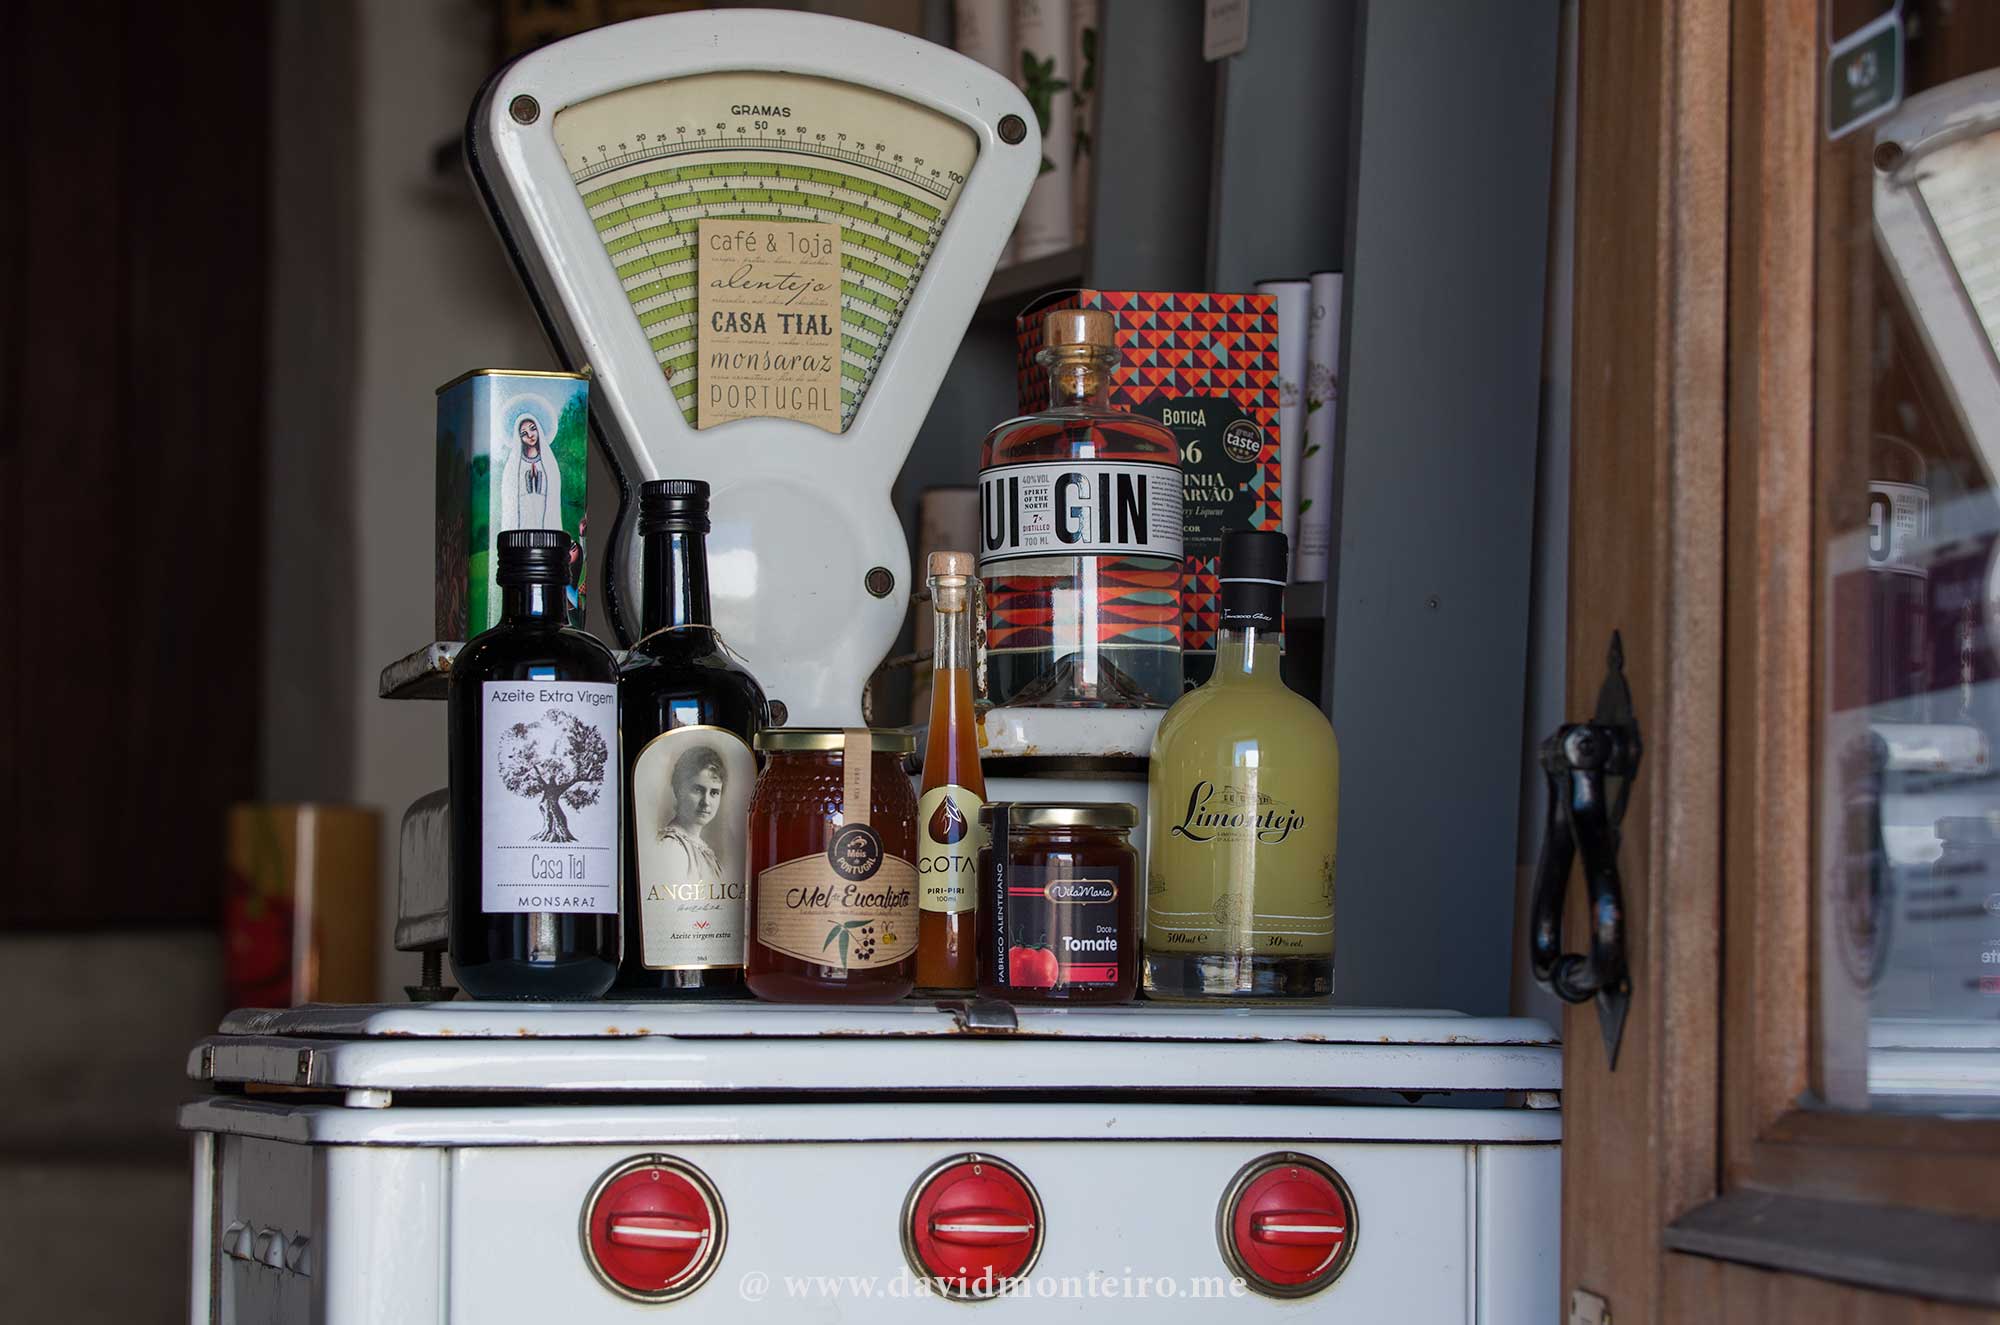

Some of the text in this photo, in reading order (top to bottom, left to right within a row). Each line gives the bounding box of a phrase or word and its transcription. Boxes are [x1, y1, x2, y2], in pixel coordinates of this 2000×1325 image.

[731, 104, 792, 118] GRAMAS
[582, 156, 588, 164] 5
[618, 143, 627, 151] 15
[636, 134, 646, 142] 20
[656, 134, 667, 142] 25
[676, 126, 686, 134] 30
[754, 121, 768, 130] 50
[796, 126, 807, 134] 60
[816, 134, 826, 142] 65
[838, 133, 846, 141] 70
[856, 142, 865, 150] 75
[876, 144, 886, 152] 80
[894, 154, 903, 162] 85
[914, 157, 924, 166] 90
[930, 168, 941, 178] 95
[948, 170, 964, 184] 100
[710, 230, 832, 258] café & loja
[710, 264, 833, 306] alentejo
[712, 312, 832, 336] CASA TIAL
[710, 350, 833, 372] monsaraz
[710, 384, 833, 411] PORTUGAL
[1163, 408, 1206, 427] BOTICA
[1227, 433, 1260, 452] taste
[1184, 472, 1224, 486] INHA
[1182, 486, 1234, 502] ARVÃO
[978, 476, 1020, 553] UI
[1055, 472, 1148, 546] GIN
[1022, 524, 1050, 532] DISTILLED
[1024, 536, 1048, 546] 700 ML
[492, 689, 614, 706] Azeite Extra Virgem
[531, 854, 586, 880] Casa Tial
[836, 857, 877, 874] PORTUGAL
[919, 856, 975, 874] GOTA
[518, 896, 596, 908] MONSARAZ
[786, 885, 834, 908] Mel
[842, 883, 910, 910] Eucalipto
[997, 863, 1005, 934] ALENTEJANO
[692, 932, 714, 940] virgem
[1096, 925, 1112, 933] Doce
[1062, 936, 1118, 951] Tomate
